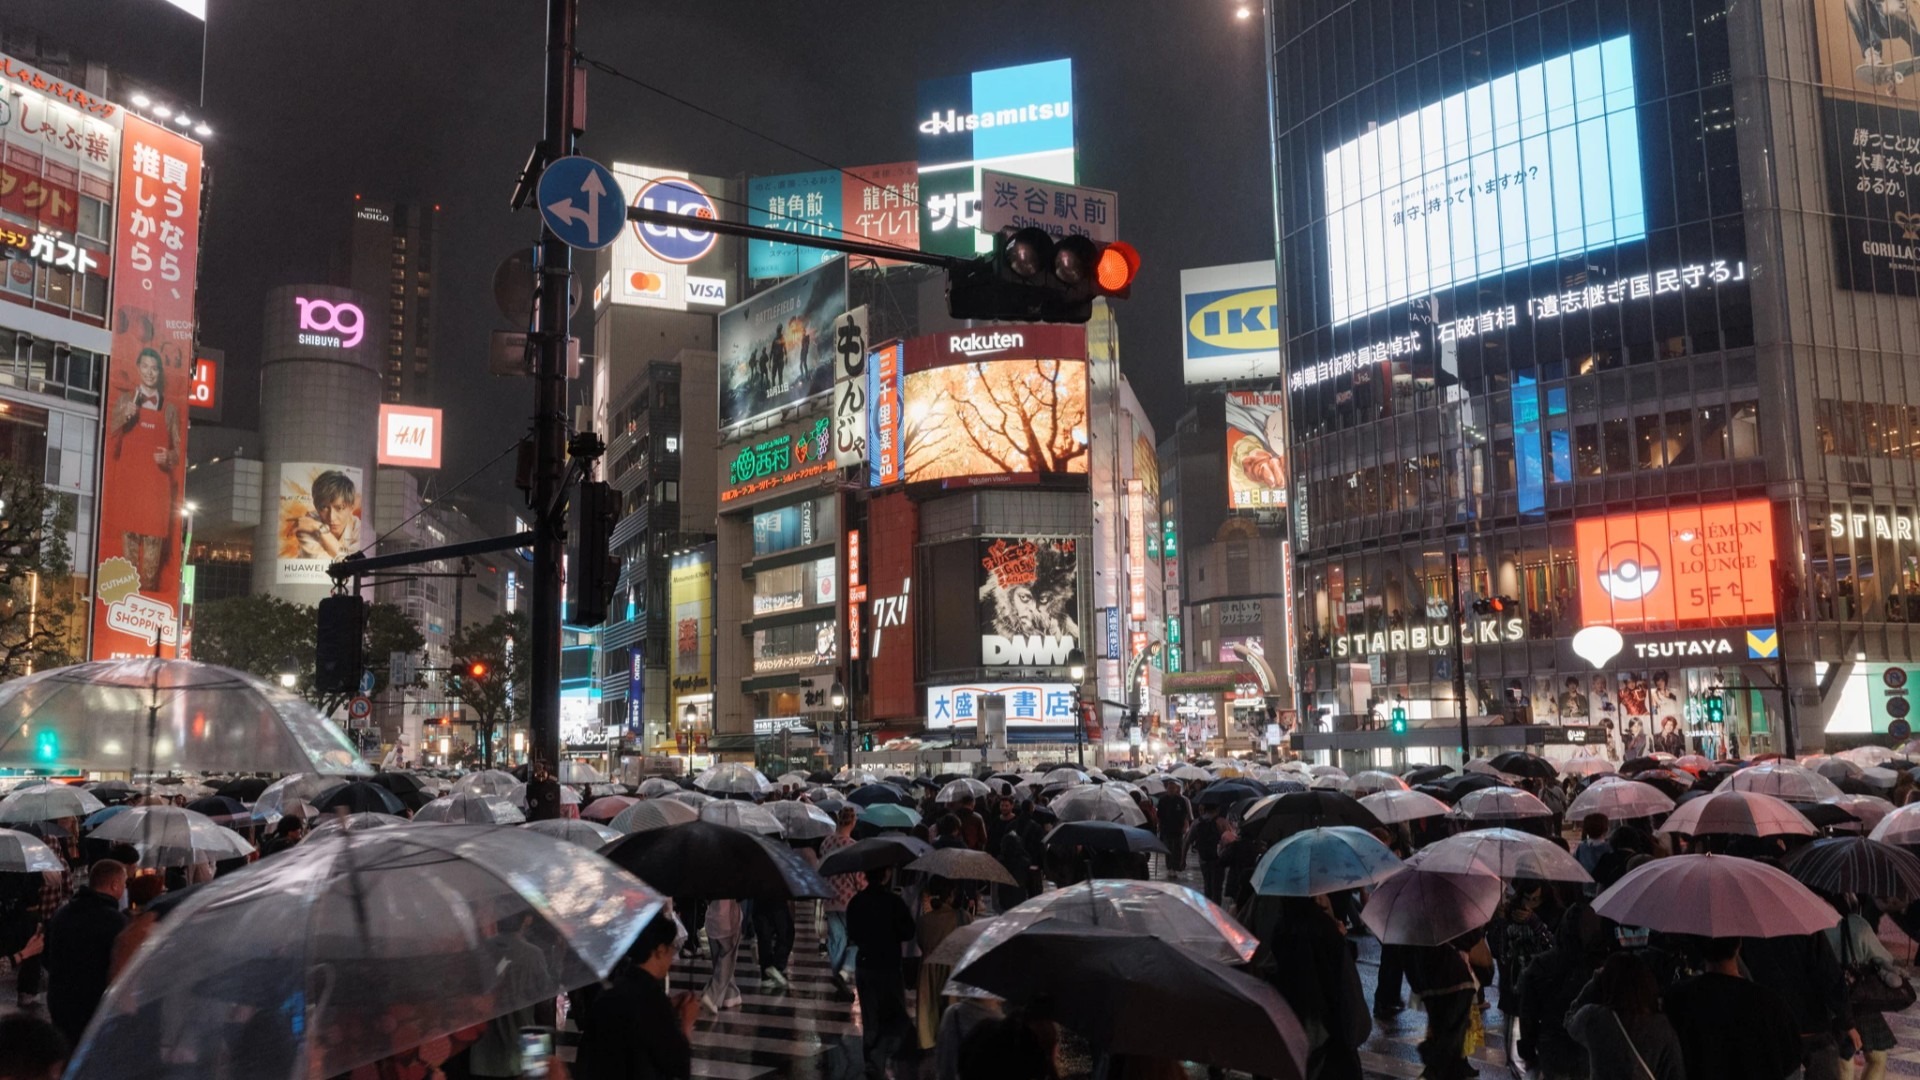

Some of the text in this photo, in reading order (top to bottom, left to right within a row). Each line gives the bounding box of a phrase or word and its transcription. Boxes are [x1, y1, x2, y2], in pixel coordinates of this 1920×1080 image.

[0, 57, 116, 119] しゃぶバイキング
[920, 101, 1069, 134] Hisamitsu
[20, 103, 109, 163] しゃぶ葉
[863, 182, 919, 211] 龍角散
[1857, 176, 1905, 198] あるか。
[357, 211, 390, 222] INDIGO
[769, 192, 823, 221] 龍角散
[994, 181, 1106, 225] 渋谷駅前
[30, 231, 97, 275] ガスト
[688, 283, 724, 298] VISA
[296, 297, 364, 348] 109
[756, 298, 795, 325] BATTLEFIELD
[1437, 305, 1516, 343] 石破首相
[299, 334, 340, 348] SHIBUYA
[950, 333, 1023, 353] Rakuten
[837, 314, 866, 459] もんじゃ
[880, 352, 892, 477] 三千里薬品
[395, 426, 426, 446] H&M
[755, 445, 790, 477] 西村
[1830, 512, 1920, 540] STAR
[1690, 541, 1743, 557] CARD
[284, 564, 325, 572] HUAWEI
[1680, 555, 1757, 574] LOUNGE
[101, 575, 135, 592] CUTMAN
[1221, 613, 1261, 624] クリニック
[1231, 602, 1261, 613] れいわ
[115, 611, 174, 637] SHOPPING!
[1337, 618, 1523, 656] STARBUCKS
[982, 635, 1076, 665] DMM
[1634, 638, 1733, 658] TSUTAYA
[935, 692, 1072, 720] 大盛書店
